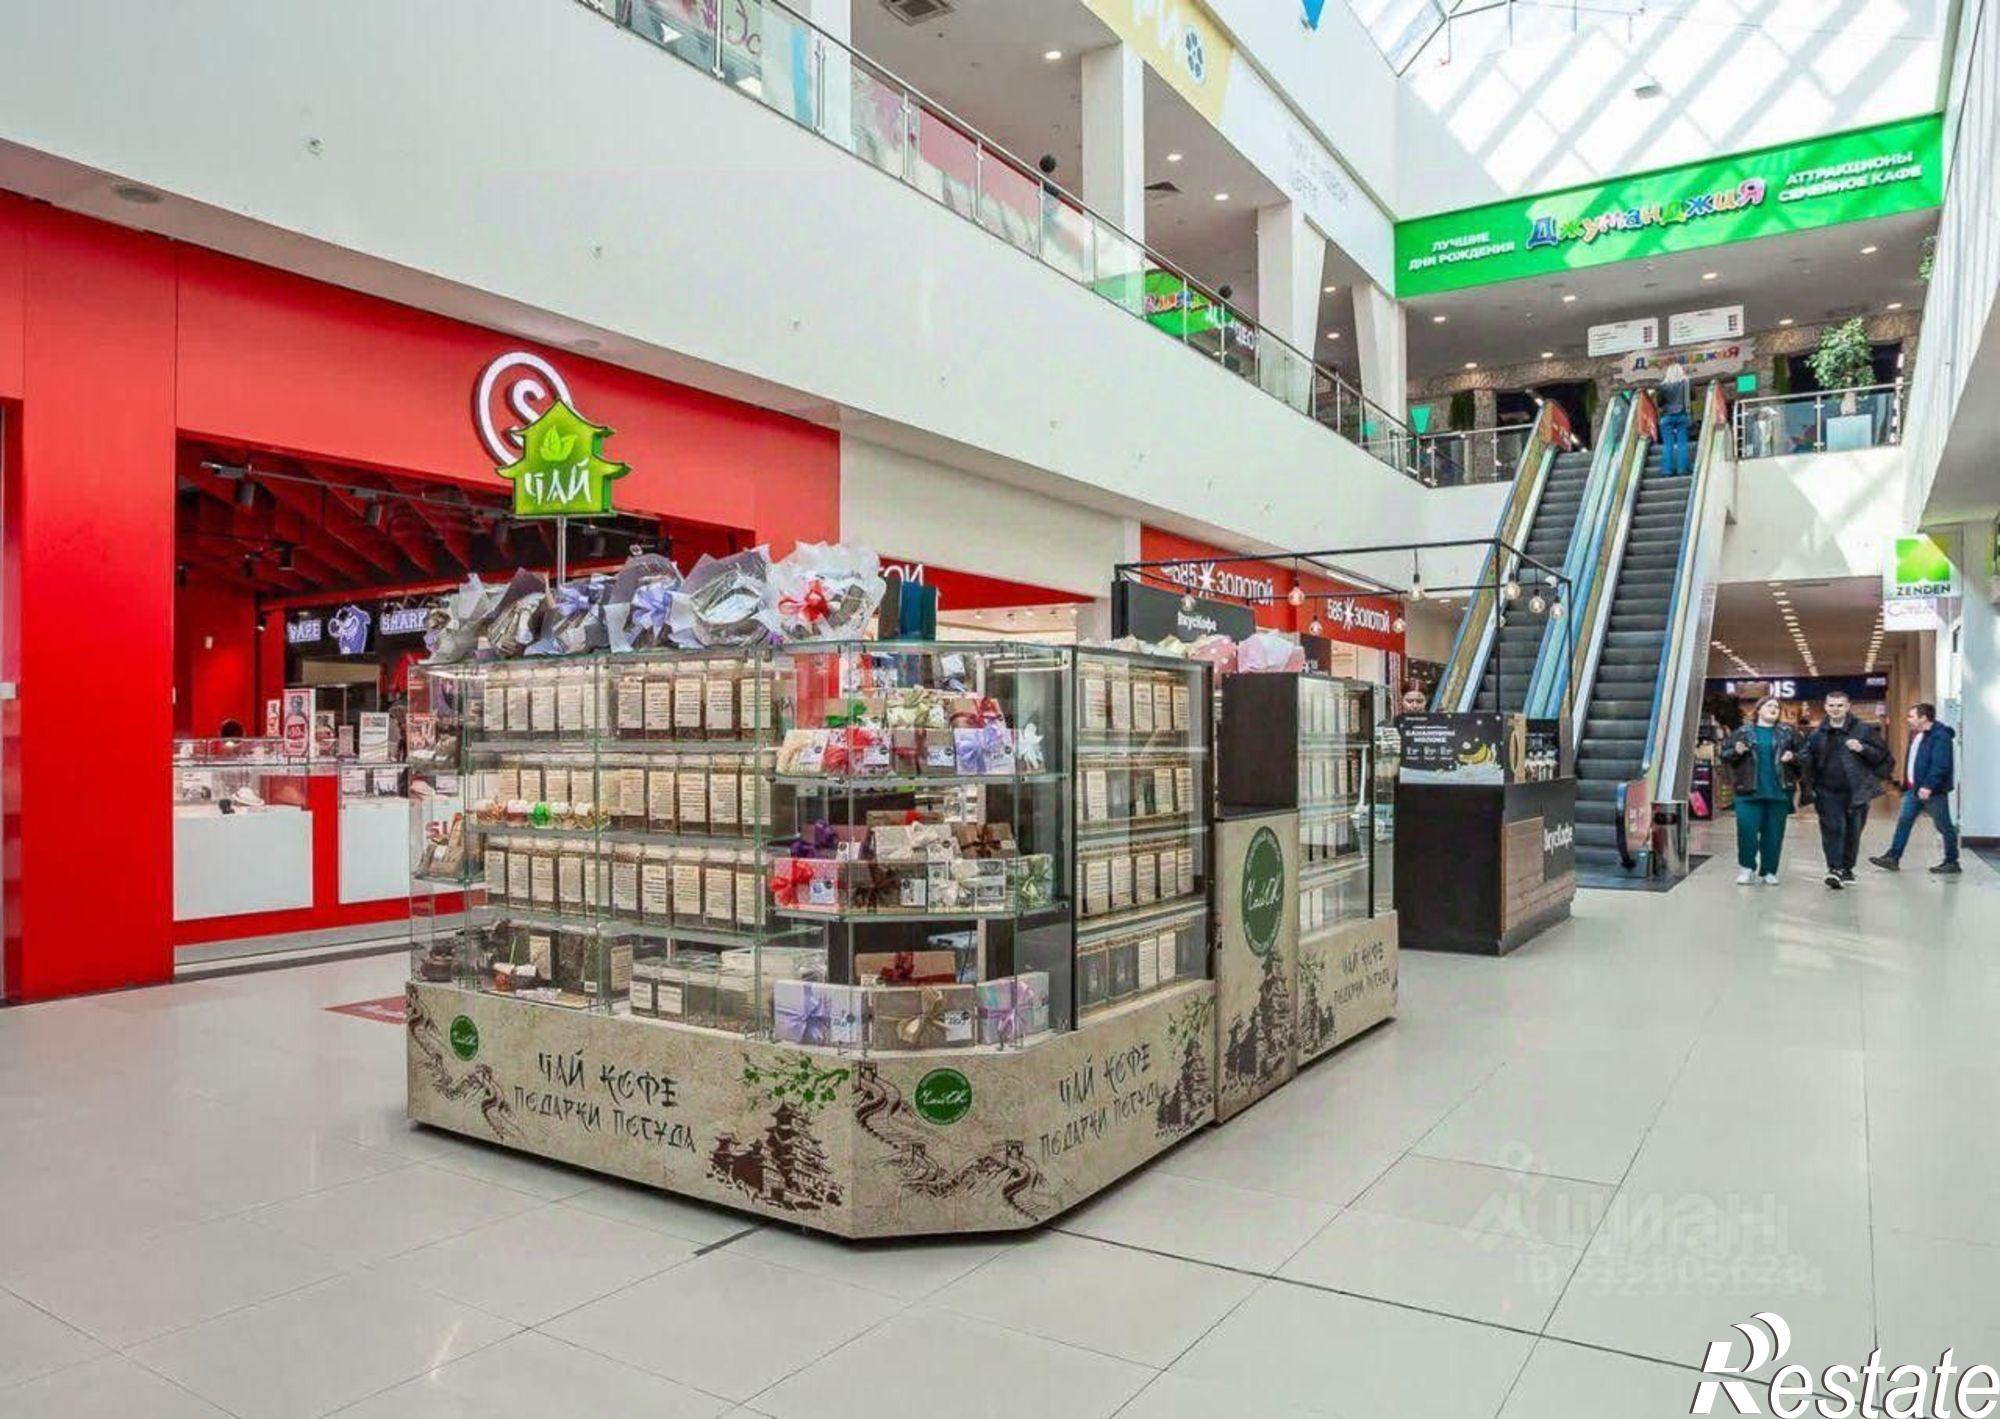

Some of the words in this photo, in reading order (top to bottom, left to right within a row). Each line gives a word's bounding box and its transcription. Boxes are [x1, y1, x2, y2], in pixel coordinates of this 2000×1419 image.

[1786, 152, 1914, 186] АТТРАКЦИОНЫ
[1872, 165, 1923, 185] КАФЕ
[1408, 256, 1437, 272] ДНИ
[1438, 241, 1516, 266] РОЖДЕНИЯ
[1432, 232, 1491, 252] ЛУЧШИЕ
[524, 457, 592, 505] ЧАЙ
[1216, 570, 1274, 607] ЗОЛОТОЙ
[1896, 583, 1951, 596] ZENDEN
[287, 620, 321, 643] VAPE
[381, 609, 428, 634] SHARK
[1355, 607, 1390, 634] ЗОЛОТОЙ
[538, 1049, 586, 1091] ЧАЙ
[600, 1064, 679, 1108] КОФЕ
[1059, 1054, 1095, 1107] ЧАЙ
[1103, 1044, 1150, 1094] КОФЕ
[514, 1086, 601, 1133] ПОДАРКИ
[612, 1108, 697, 1153] ПОСУДА
[1040, 1107, 1107, 1166] ПОДАРКИ
[1113, 1081, 1169, 1124] ПОСУДА
